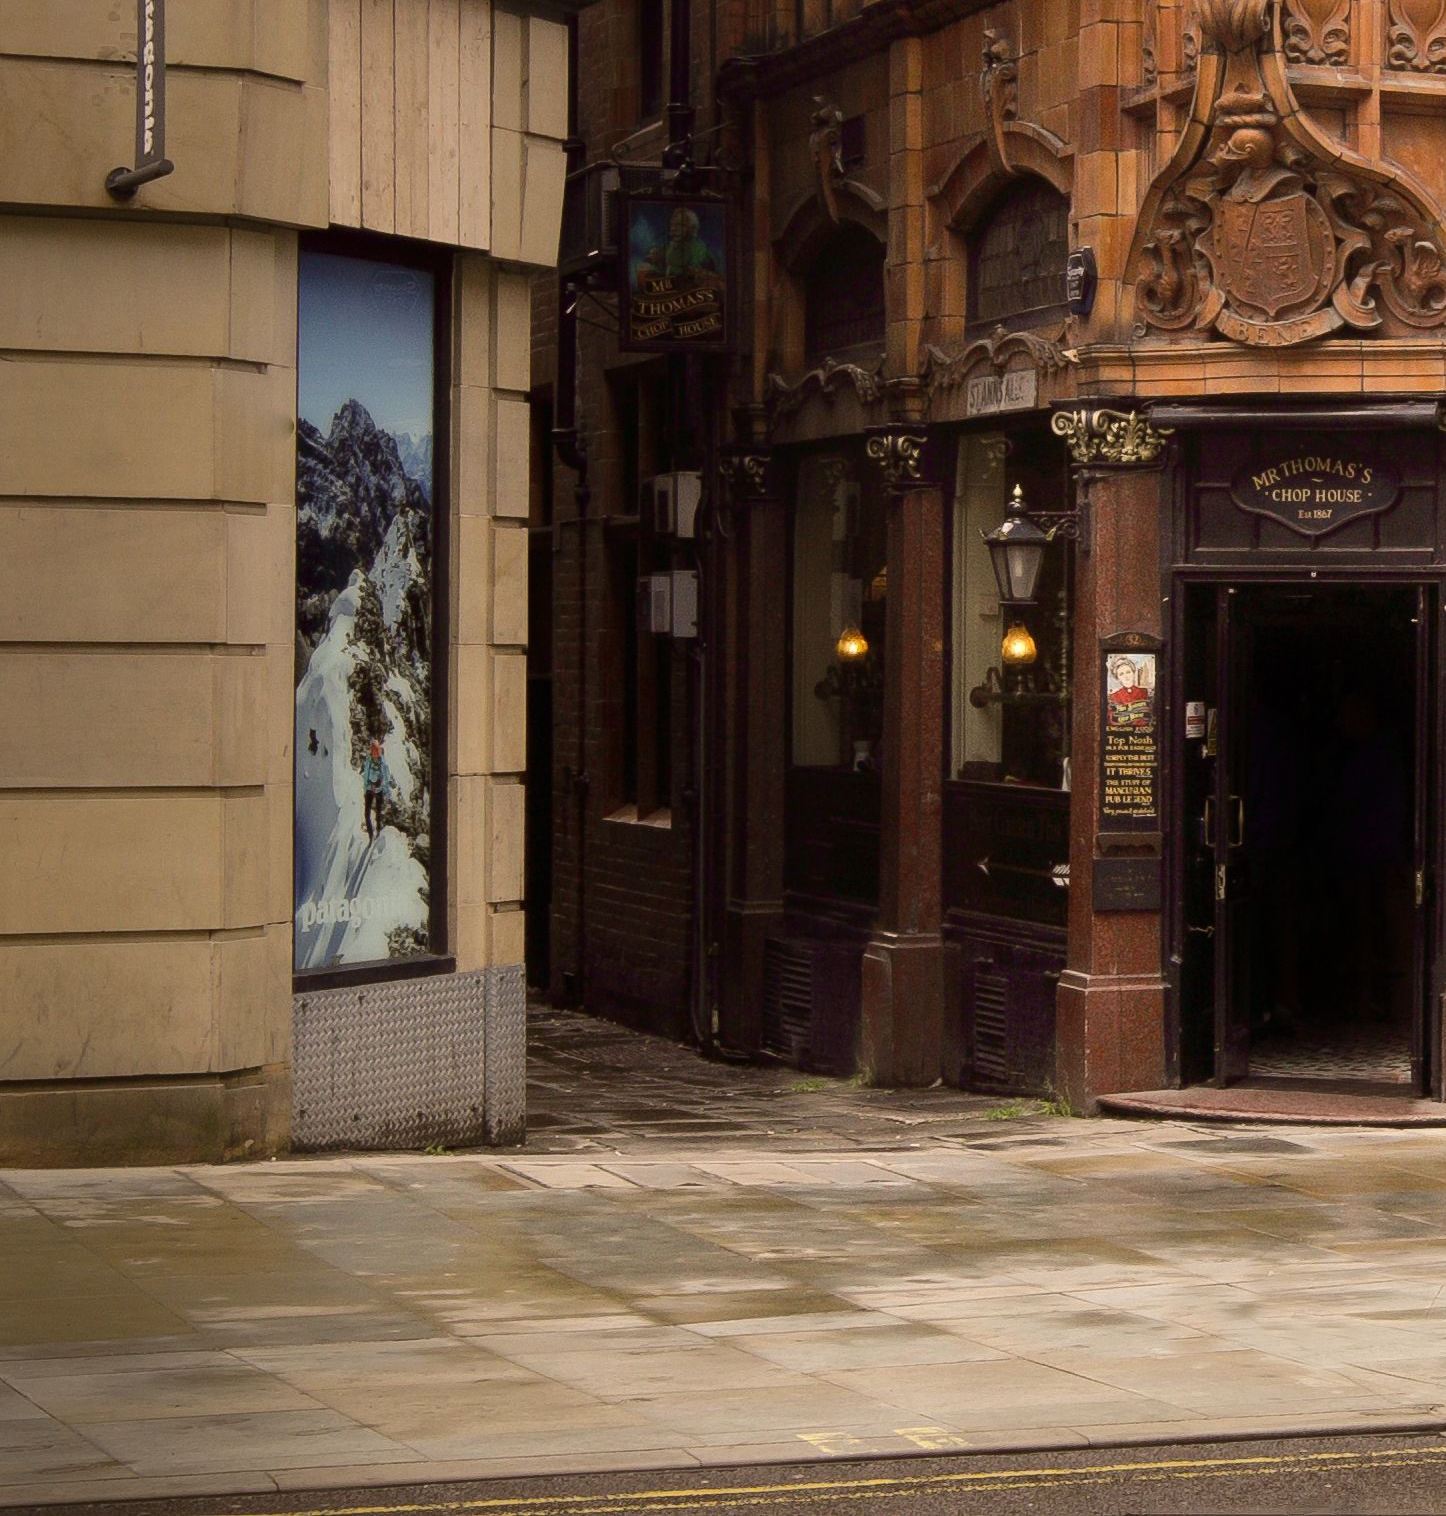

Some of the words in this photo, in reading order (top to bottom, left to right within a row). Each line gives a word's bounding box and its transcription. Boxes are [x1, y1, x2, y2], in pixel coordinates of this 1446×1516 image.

[1252, 469, 1280, 490] MR
[1280, 457, 1373, 484] THOMAS'S
[1272, 489, 1310, 502] CHOP
[1316, 489, 1362, 502] HOUSE
